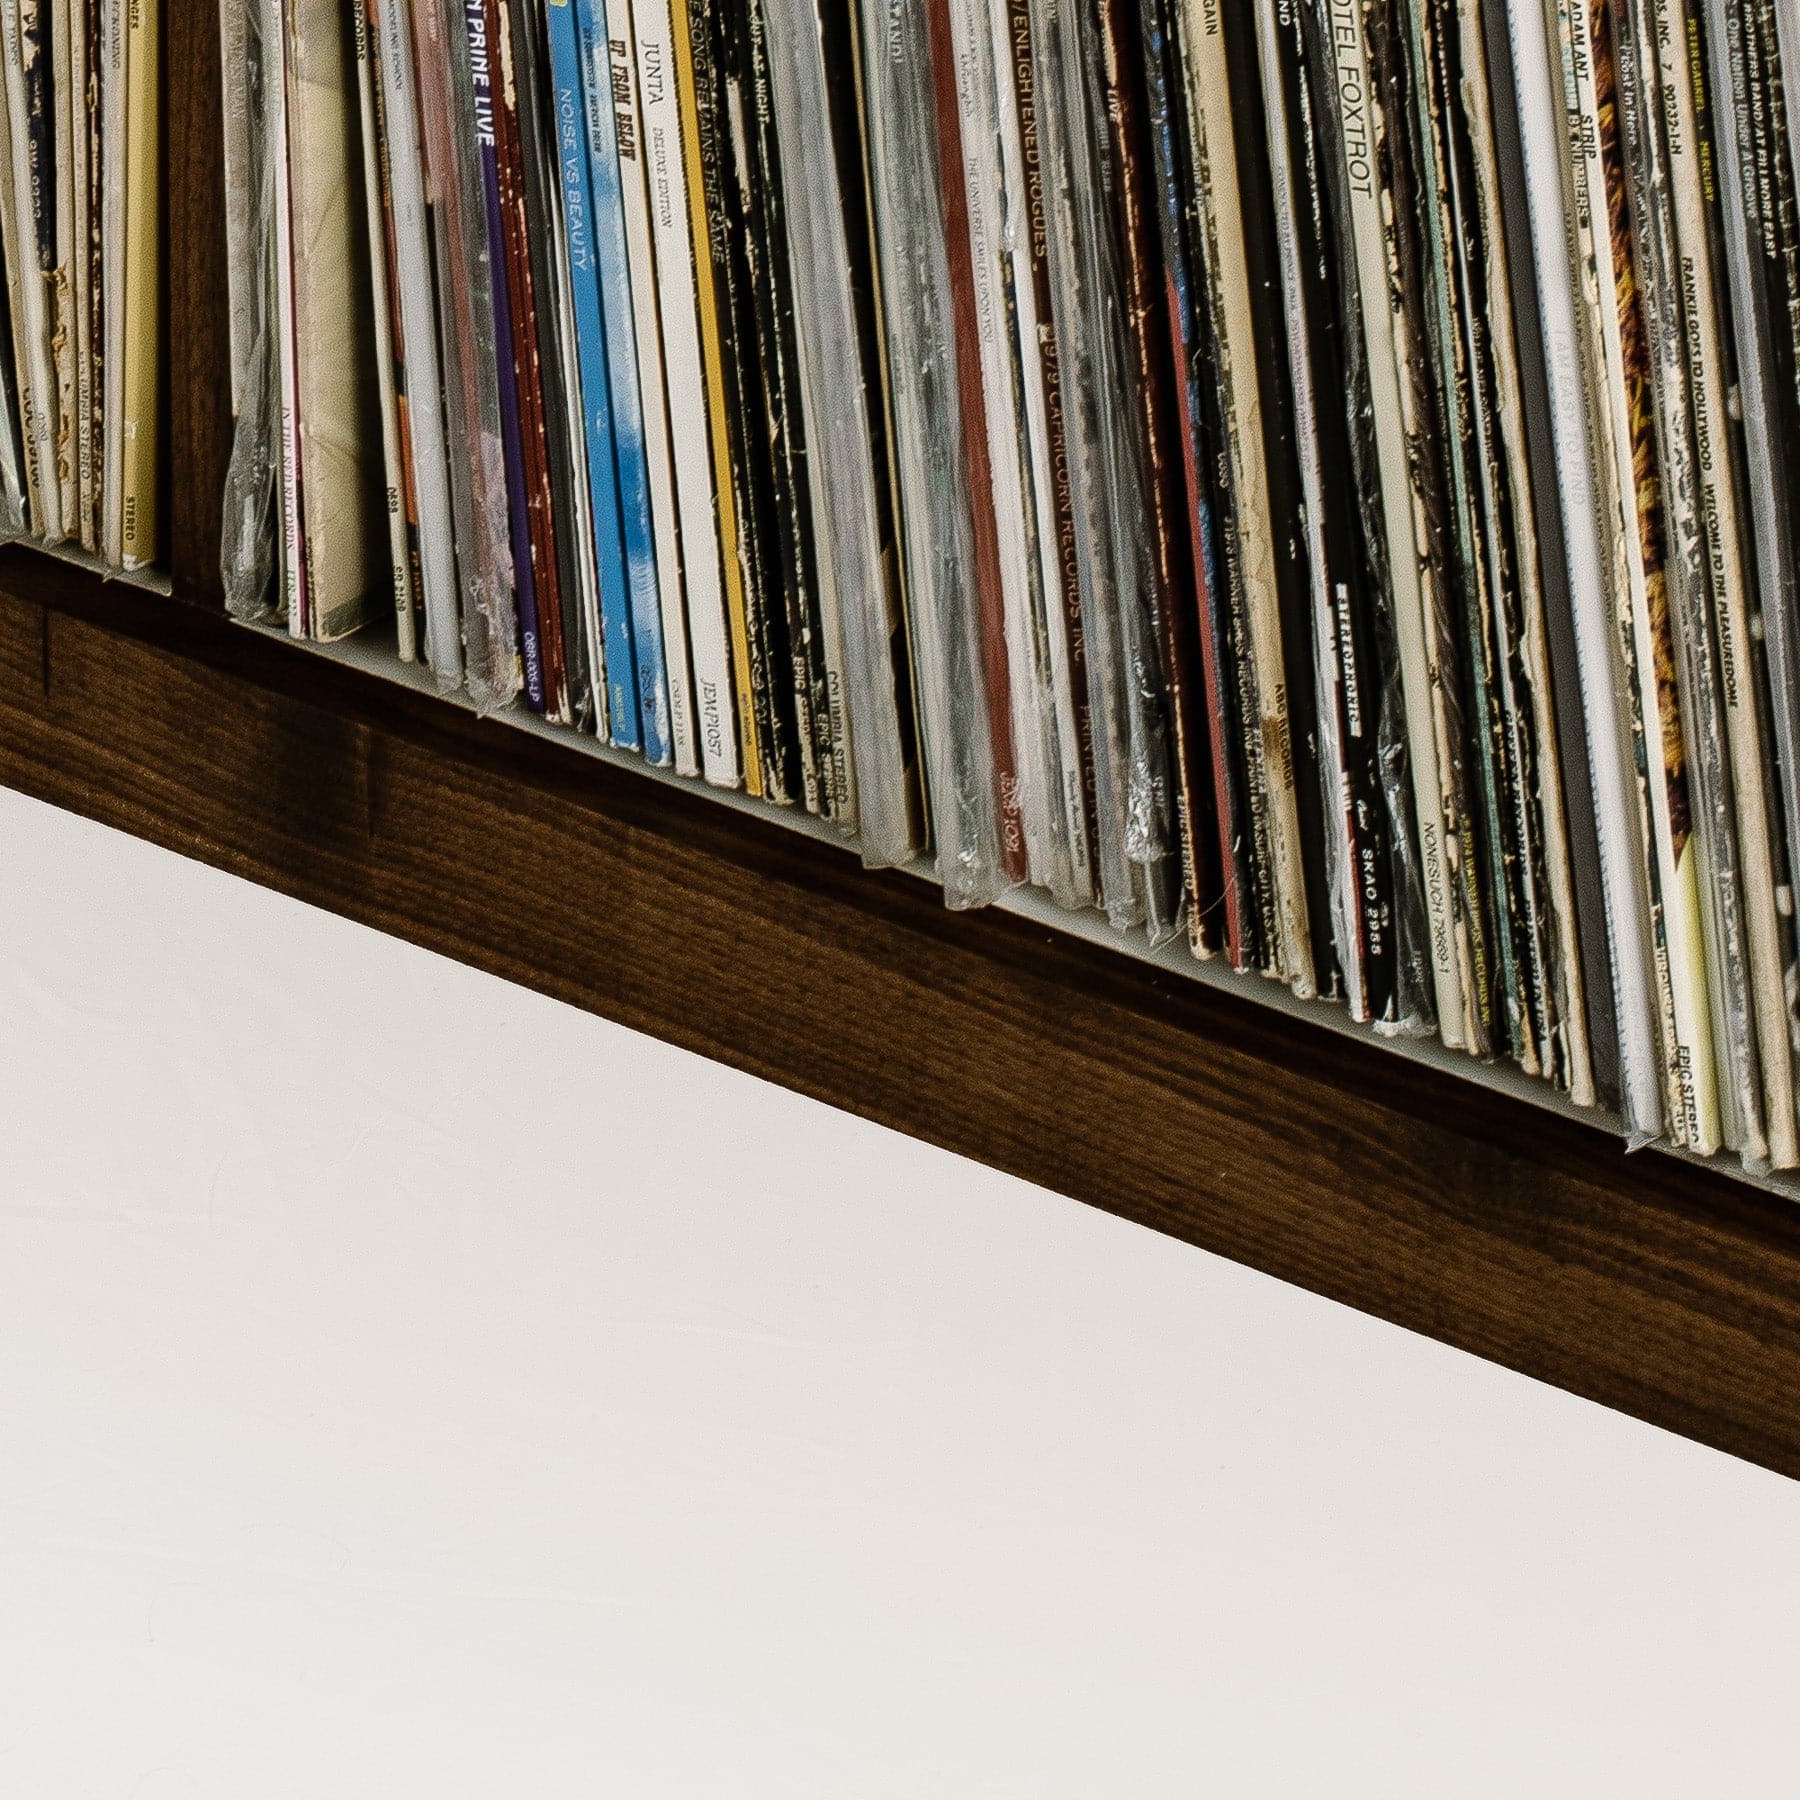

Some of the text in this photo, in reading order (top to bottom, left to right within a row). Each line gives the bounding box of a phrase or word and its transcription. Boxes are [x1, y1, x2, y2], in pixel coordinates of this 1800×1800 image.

[465, 16, 489, 88] PRINE
[472, 95, 495, 148] LIVE
[557, 87, 577, 150] NOISE
[609, 38, 636, 162] UP FROM BELOW
[641, 38, 672, 229] JUNTA DELUXE EDITION
[1339, 64, 1371, 201] FOXTROT
[563, 157, 580, 184] VS
[566, 188, 588, 271] BEAUTY
[1027, 170, 1048, 257] ROGUES
[124, 495, 134, 541] STEREO
[1680, 255, 1739, 708] FRANKIE GOES TO HOLLYWOOD WELCOME TO THE PLEASUREDOME
